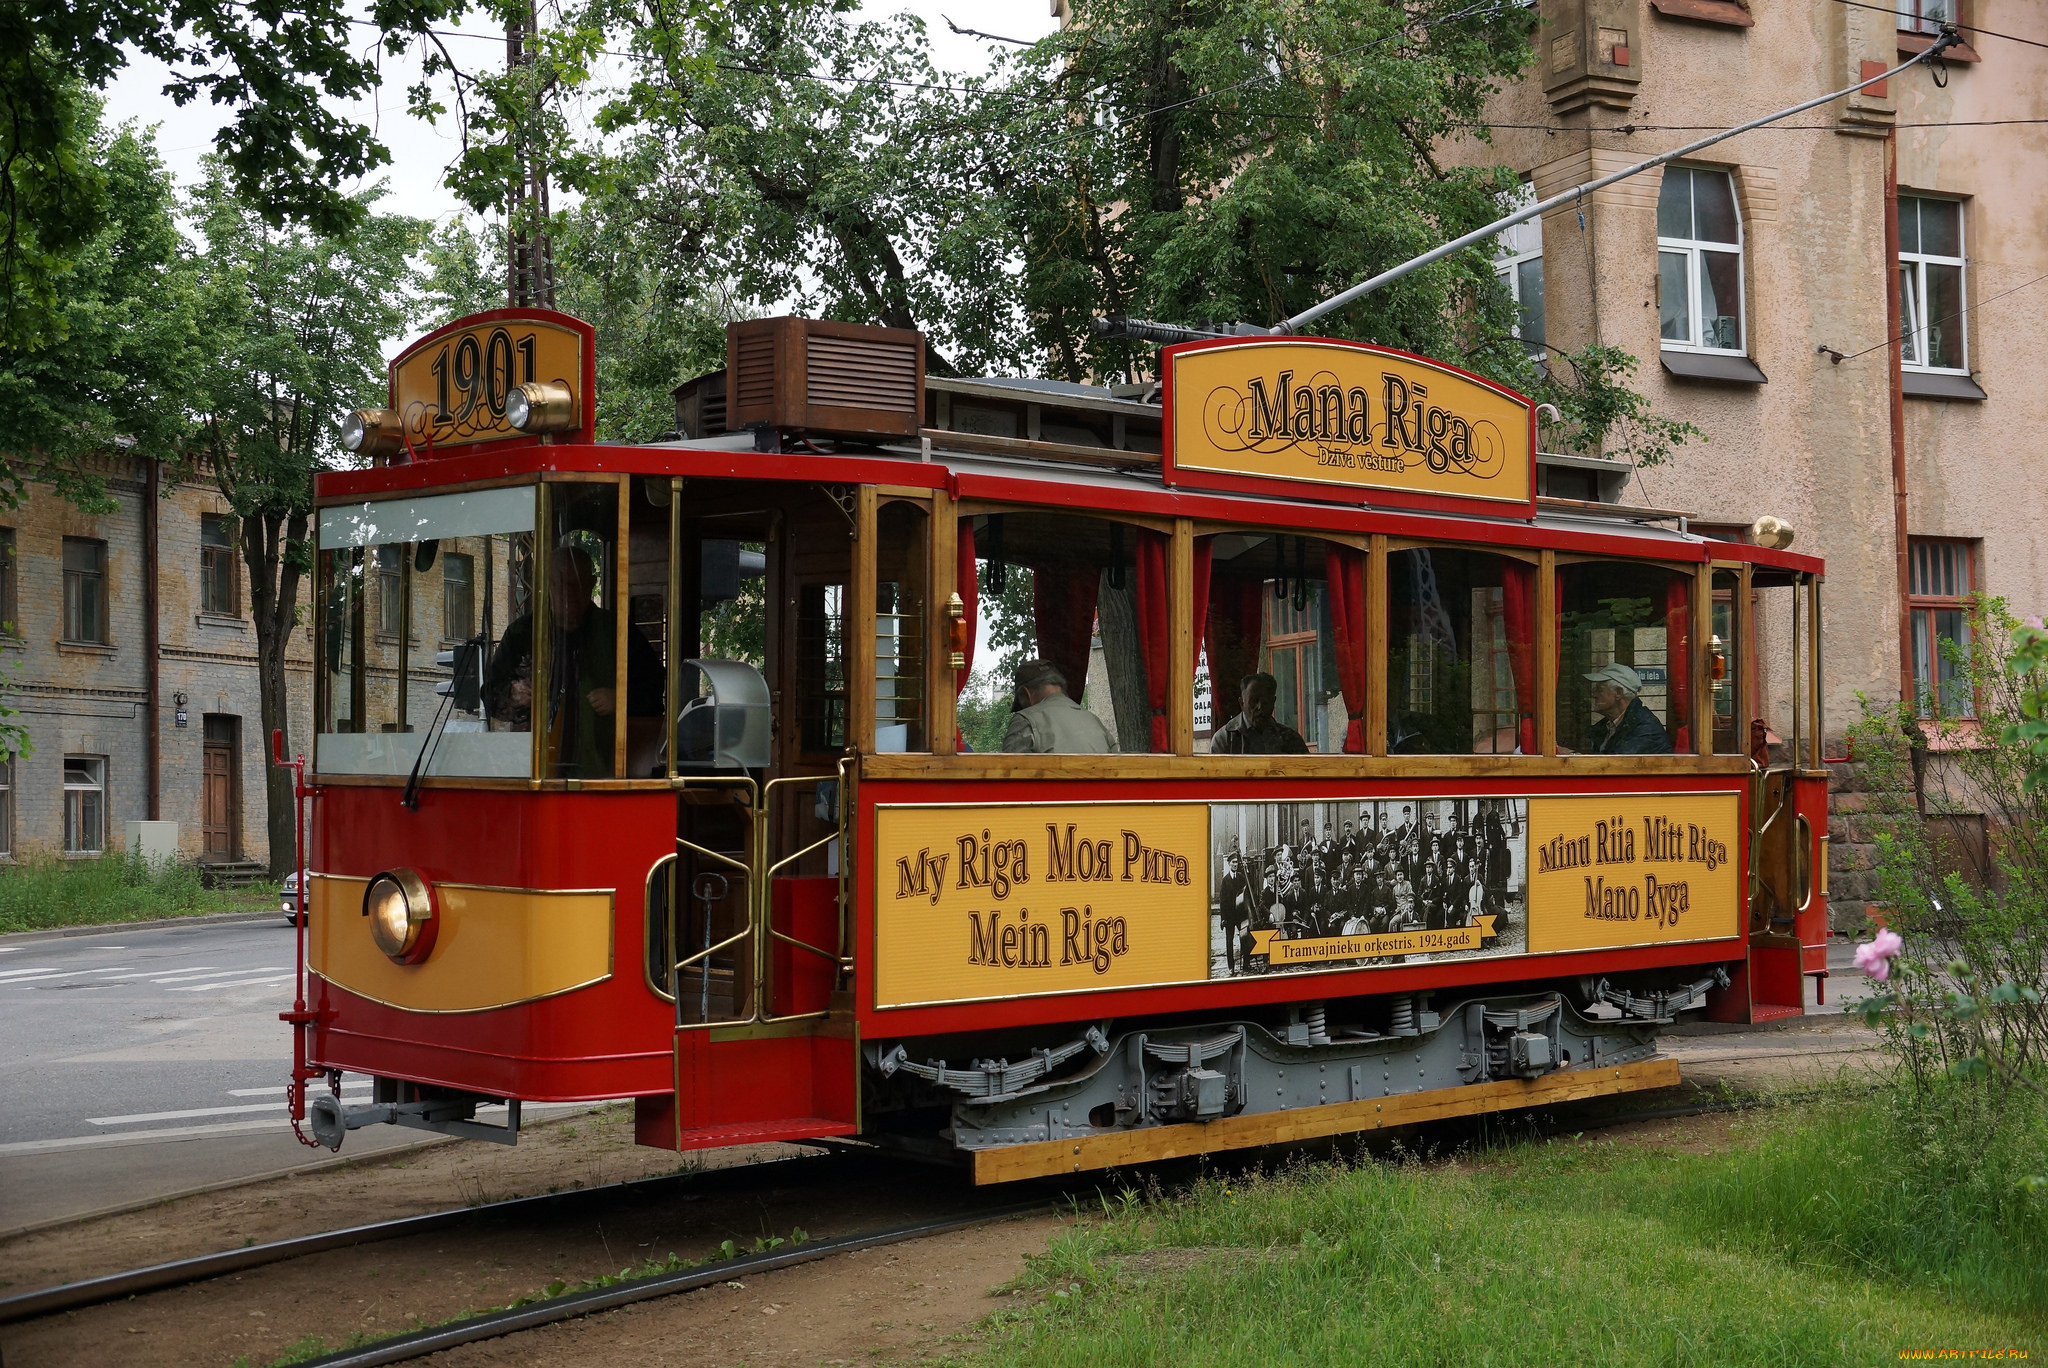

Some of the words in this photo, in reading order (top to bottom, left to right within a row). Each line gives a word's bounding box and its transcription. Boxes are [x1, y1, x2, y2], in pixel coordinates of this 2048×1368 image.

[430, 327, 537, 428] 1901
[1248, 370, 1373, 446] Mana
[1382, 371, 1474, 475] Rīga
[1318, 446, 1356, 468] Dzīva
[1357, 451, 1405, 473] vēsture
[177, 712, 187, 721] 170
[896, 847, 950, 906] My
[956, 828, 1030, 900] Riga
[1045, 823, 1114, 882] Моя
[1120, 829, 1191, 886] Рига
[1538, 833, 1592, 873] Minu
[1595, 815, 1636, 865] Riia
[1643, 815, 1684, 862] Mitt
[1687, 823, 1728, 871] Riga
[1584, 876, 1640, 921] Mano
[1644, 873, 1690, 930] Ryga
[968, 907, 1052, 968] Mein
[1059, 904, 1130, 975] Riga
[1282, 941, 1361, 958] Tramvajnieku
[1364, 937, 1415, 955] orķestris.
